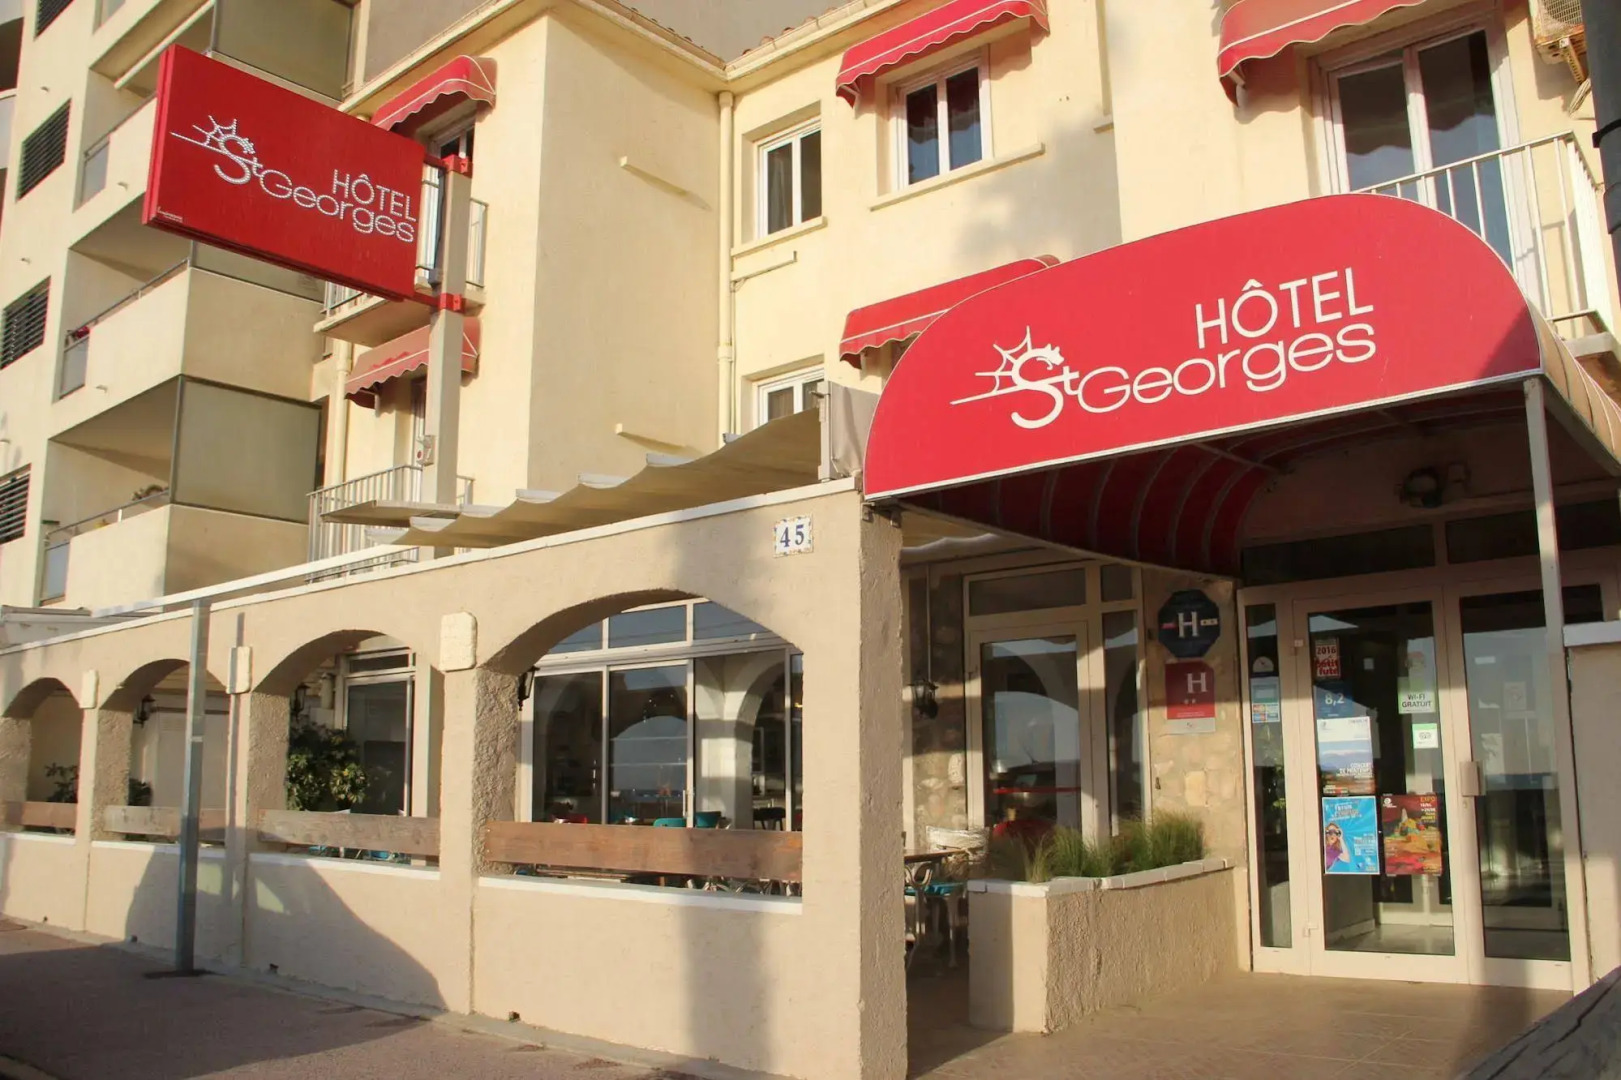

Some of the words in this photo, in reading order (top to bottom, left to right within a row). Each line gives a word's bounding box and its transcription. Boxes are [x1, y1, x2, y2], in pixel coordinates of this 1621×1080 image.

[259, 169, 415, 243] Georges
[332, 169, 417, 223] HÔTEL
[1194, 267, 1375, 349] HÔTEL
[1077, 322, 1377, 414] Georges
[779, 524, 805, 548] 45
[1178, 611, 1198, 638] H
[1316, 646, 1337, 655] 2016
[1187, 672, 1207, 693] H
[1325, 692, 1345, 706] 8,2
[1401, 700, 1432, 708] GRATUIT
